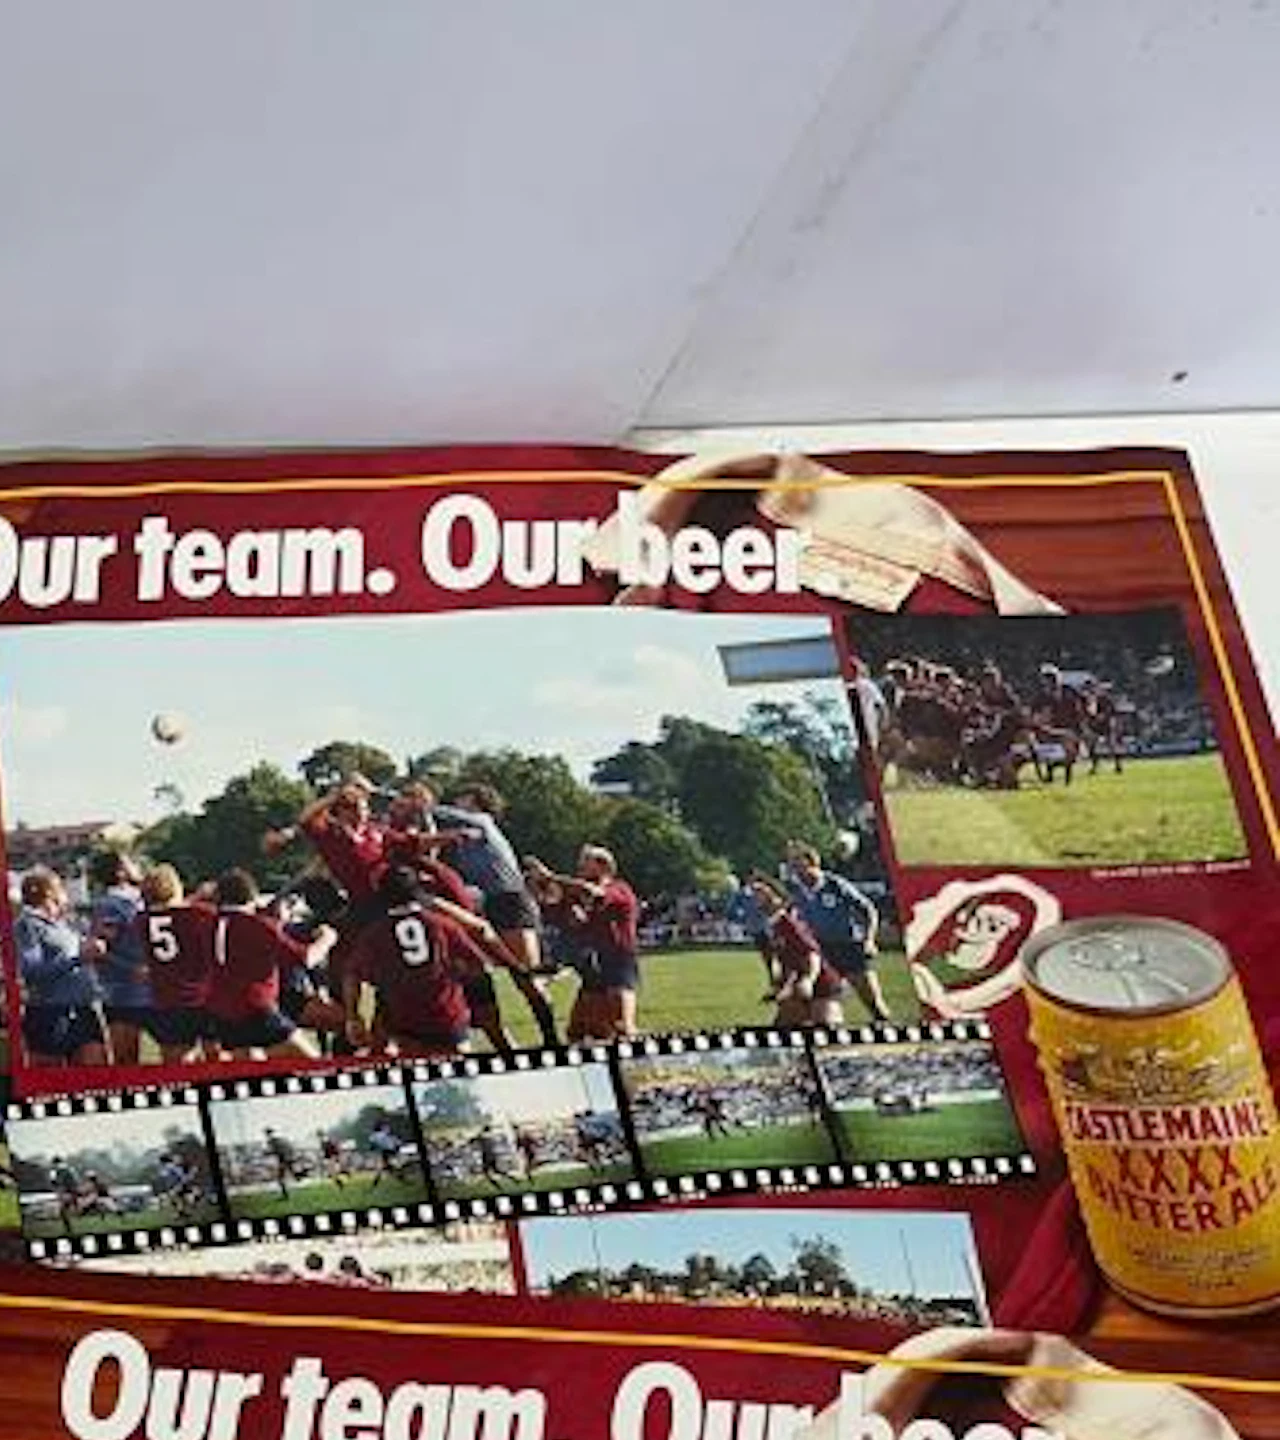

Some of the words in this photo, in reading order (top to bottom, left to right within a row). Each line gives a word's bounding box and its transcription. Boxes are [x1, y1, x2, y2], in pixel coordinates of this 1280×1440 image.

[135, 516, 396, 602] team.
[422, 494, 597, 590] Our
[394, 918, 430, 966] 9
